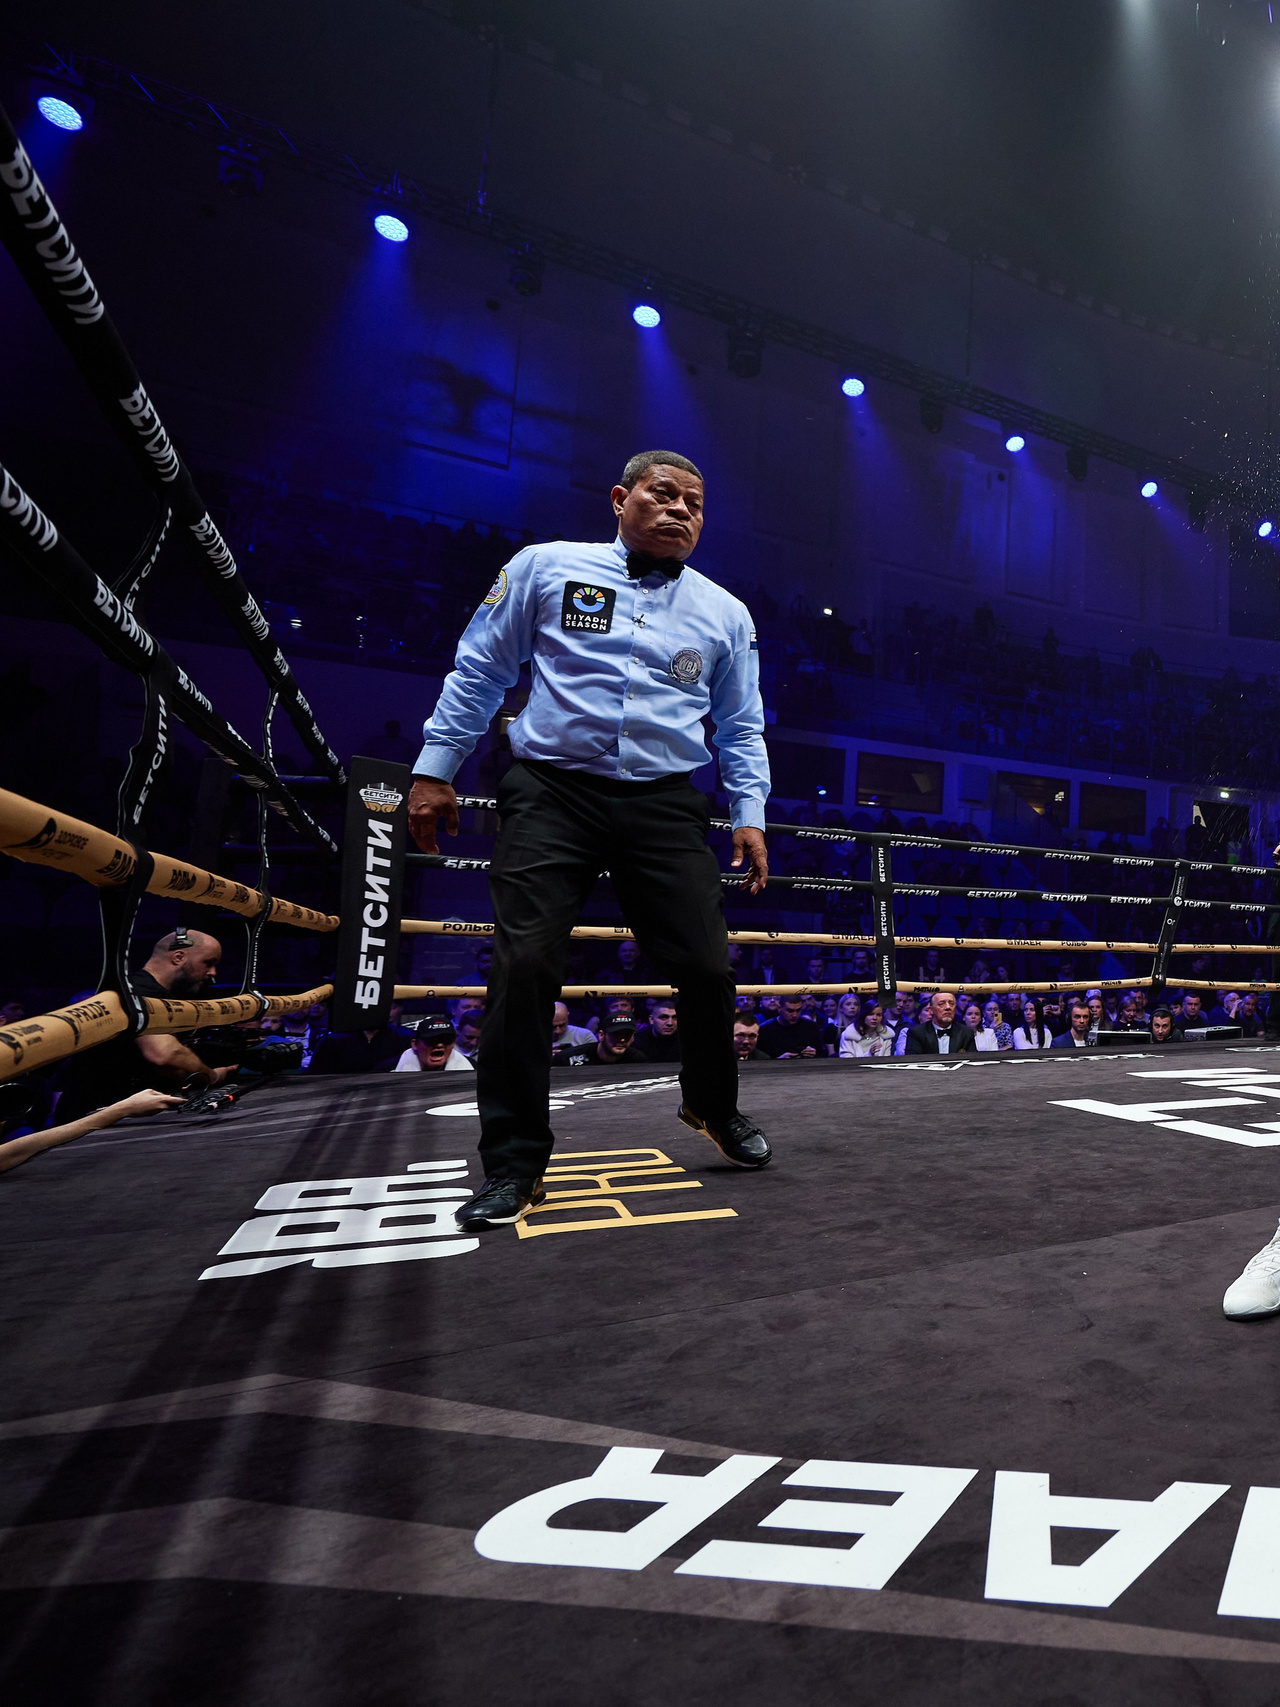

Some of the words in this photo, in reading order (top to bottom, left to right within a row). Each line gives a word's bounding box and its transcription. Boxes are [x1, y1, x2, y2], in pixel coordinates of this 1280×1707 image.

[0, 138, 104, 325] БЕТСИТИ
[0, 466, 58, 552] СИТИ
[124, 507, 172, 612] ЕТСИТИ
[565, 621, 607, 630] SEASON
[566, 614, 607, 625] RIYADH
[679, 658, 698, 674] WBA
[134, 694, 168, 825] БЕТСИТИ
[363, 790, 400, 800] БЕТСИТИ
[456, 797, 497, 809] БЕТС
[796, 831, 856, 842] БЕТСИТИ
[444, 859, 490, 871] БЕТС
[878, 847, 886, 882] БЕТСИТИ
[1044, 853, 1090, 862] БЕТСИТИ
[1113, 858, 1154, 867] БЕТСИТИ
[1231, 866, 1267, 874] БЕТСИТИ
[893, 888, 940, 896] ЕТСИТИ
[967, 890, 1017, 899] БЕТСИТИ
[1041, 893, 1088, 902] БЕТСИТИ
[1110, 896, 1152, 904] БЕТСИТИ
[1184, 900, 1211, 908] ТСИТИ
[1230, 904, 1266, 912] БЕТСИТИ
[354, 818, 393, 1009] БЕТСИТИ
[442, 923, 496, 933] РОЛЬФ
[882, 955, 891, 990] БЕТСИТИ
[514, 1147, 740, 1240] PRO
